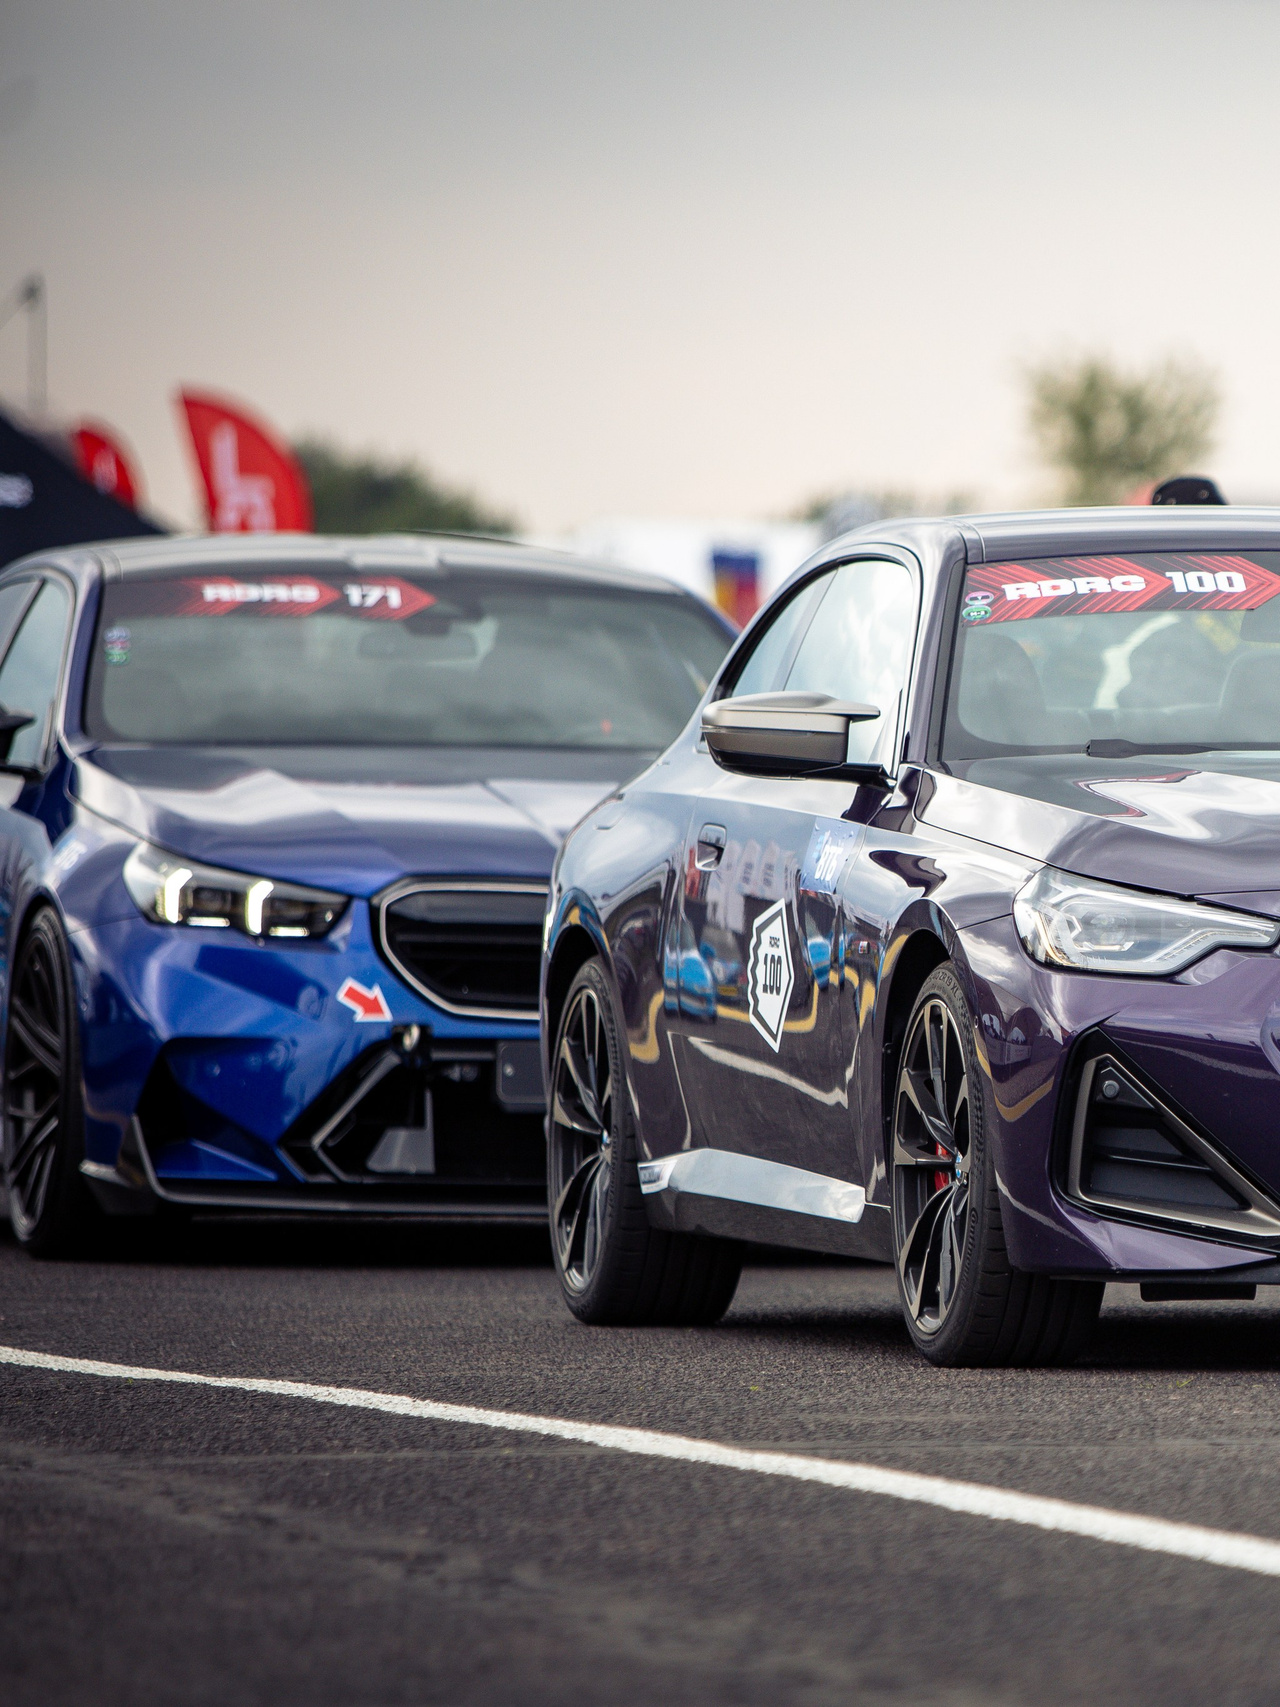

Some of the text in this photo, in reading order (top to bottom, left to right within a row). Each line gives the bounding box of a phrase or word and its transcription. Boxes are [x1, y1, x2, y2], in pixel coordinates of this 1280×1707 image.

[343, 583, 402, 609] 171
[1001, 569, 1247, 600] RDRC 100
[762, 953, 782, 996] 100
